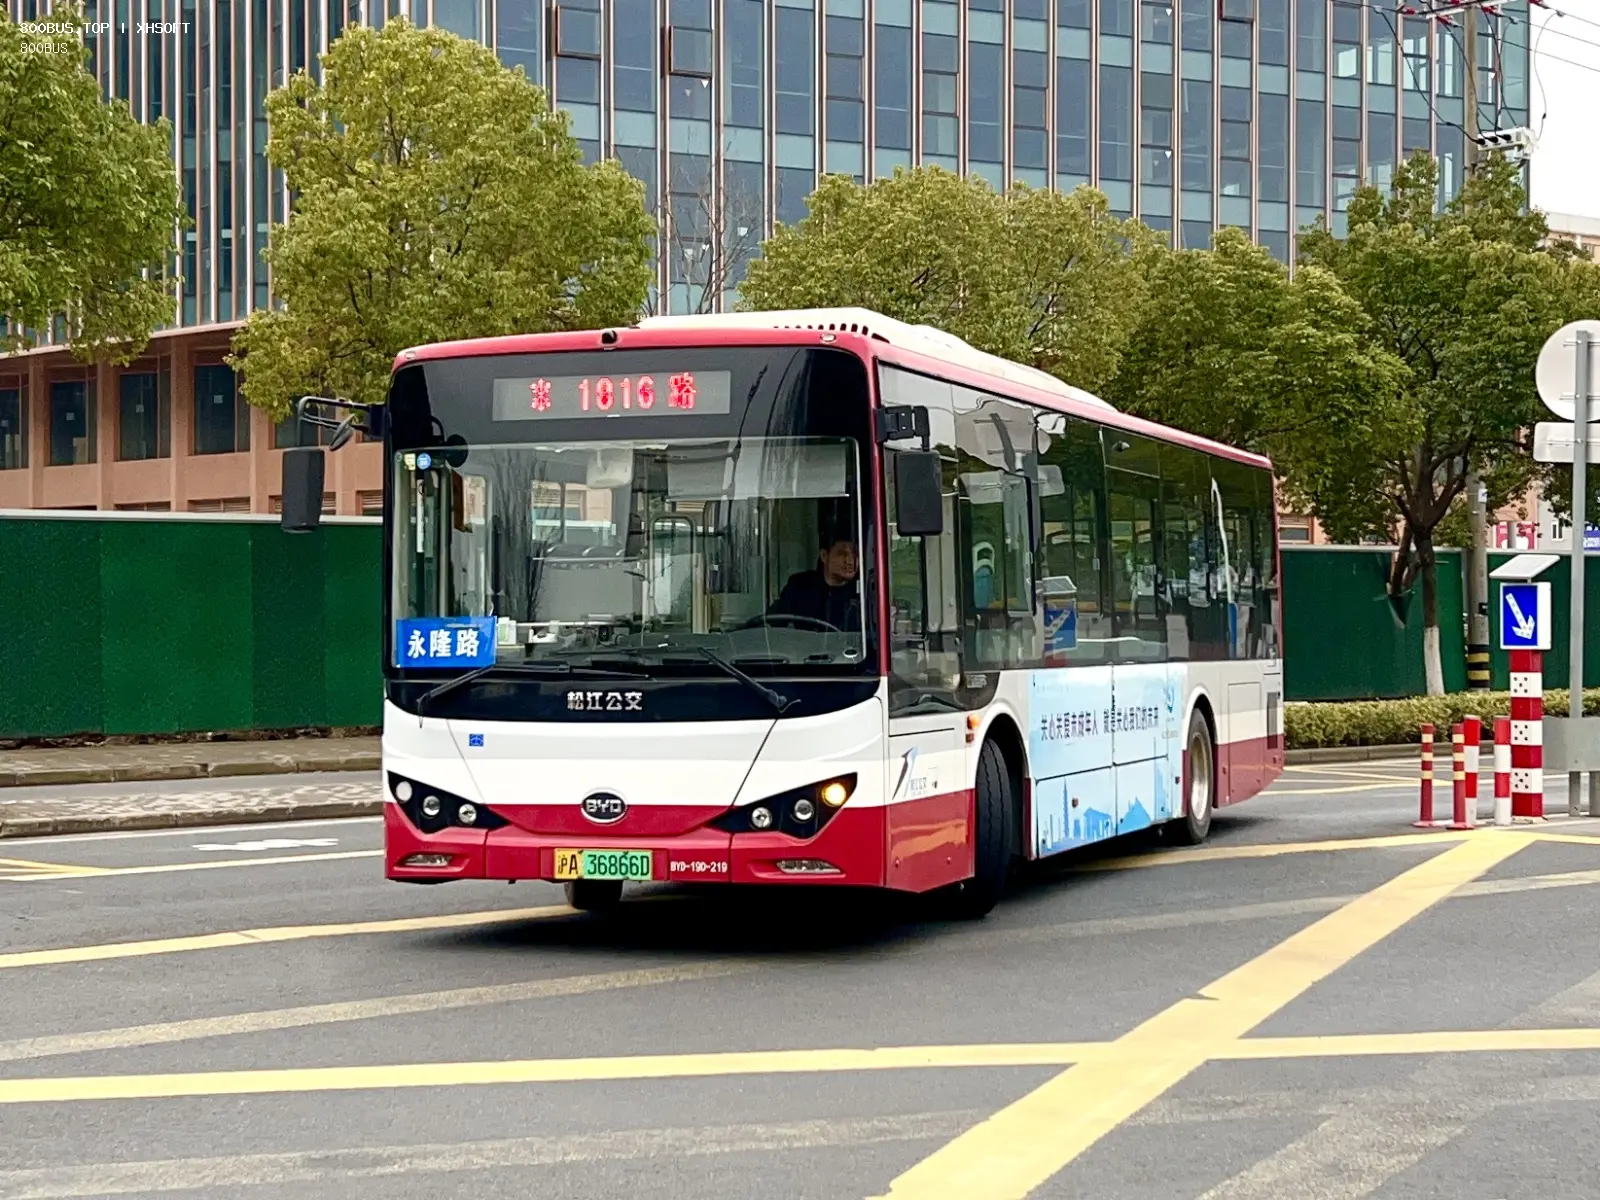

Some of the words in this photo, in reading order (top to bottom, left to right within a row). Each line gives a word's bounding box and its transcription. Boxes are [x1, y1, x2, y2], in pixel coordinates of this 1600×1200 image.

[407, 628, 480, 659] 永隆路
[566, 691, 643, 711] 松江公交
[585, 798, 622, 814] BYD
[587, 853, 650, 876] 36866D
